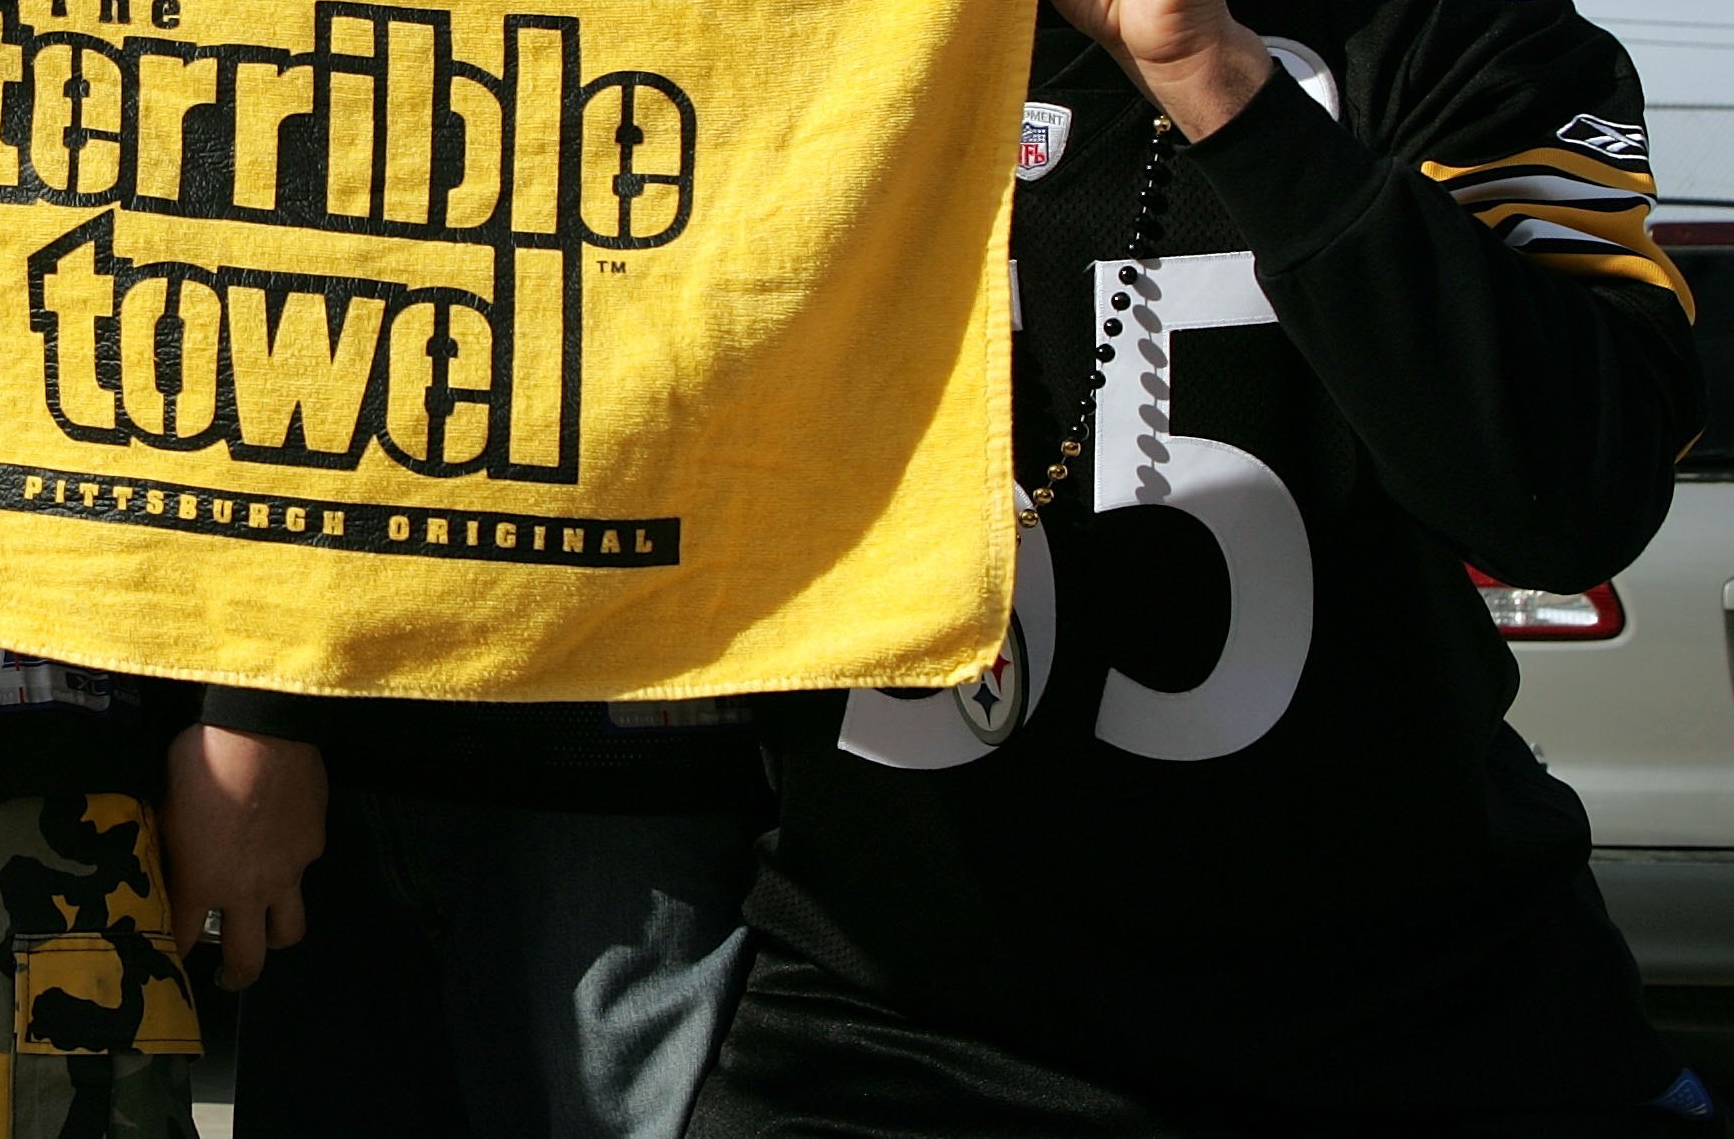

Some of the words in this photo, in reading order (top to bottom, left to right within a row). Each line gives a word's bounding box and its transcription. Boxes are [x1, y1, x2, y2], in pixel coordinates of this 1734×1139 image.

[28, 209, 579, 485] towel
[23, 475, 346, 538] PITTSBURGH
[389, 514, 653, 555] ORIGINAL
